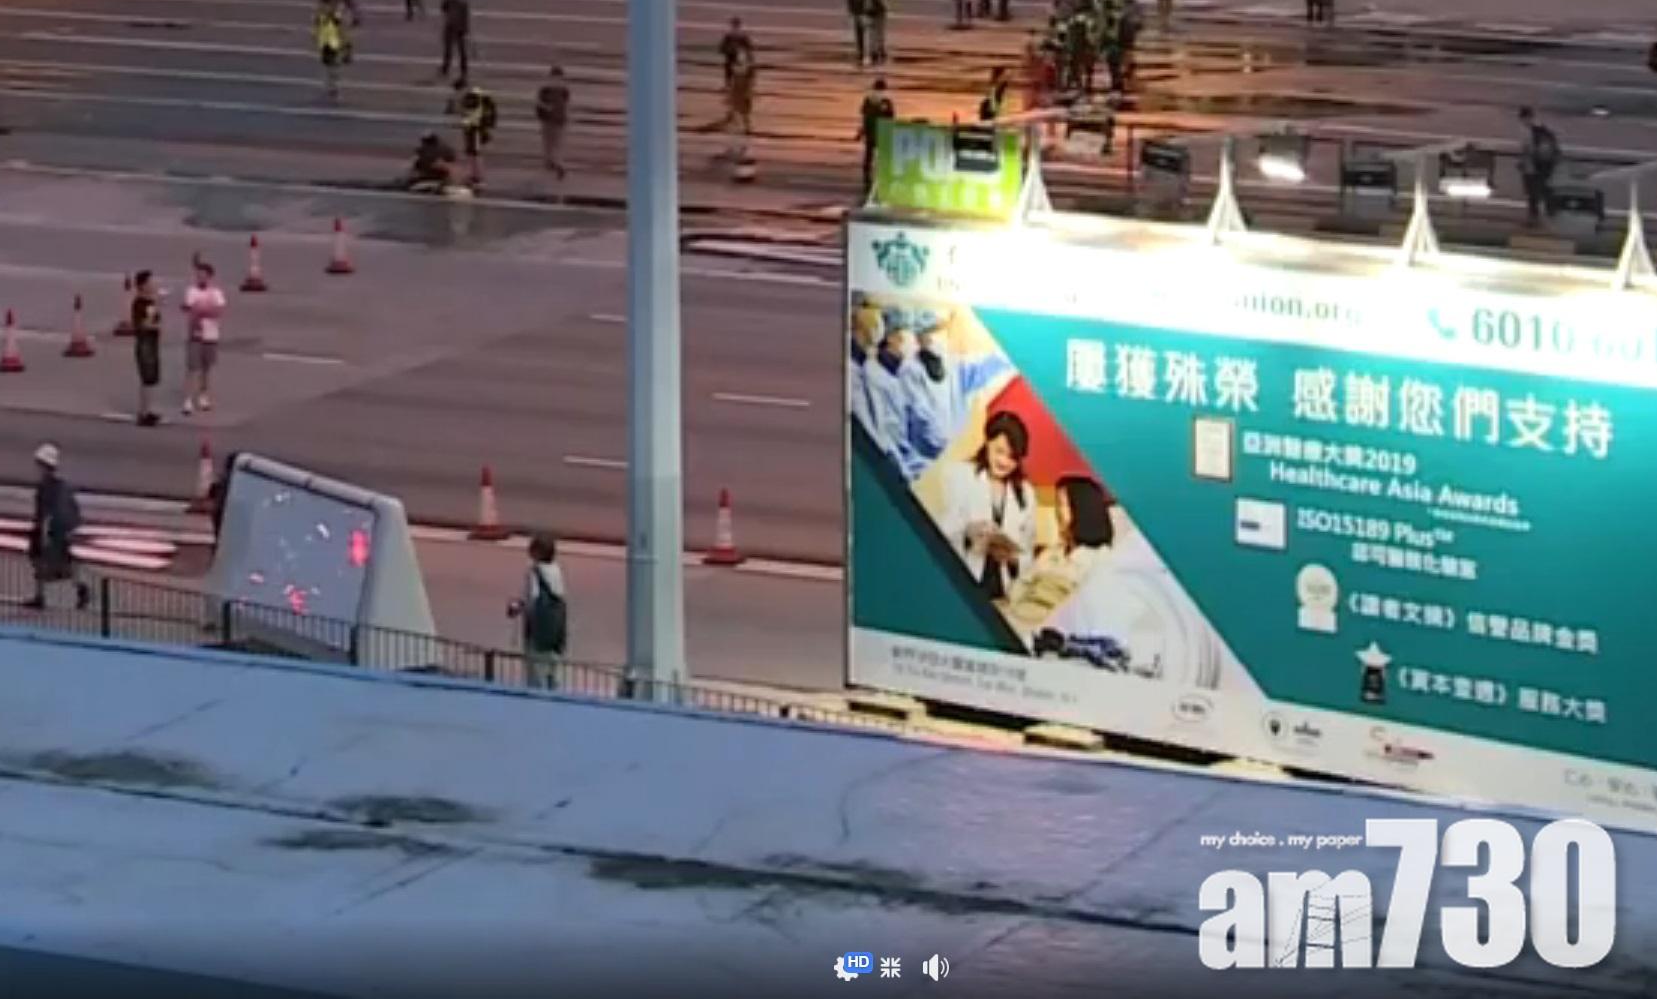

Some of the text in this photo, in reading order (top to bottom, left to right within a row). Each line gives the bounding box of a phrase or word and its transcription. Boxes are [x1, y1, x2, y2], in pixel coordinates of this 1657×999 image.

[1065, 338, 1614, 460] 屢獲殊榮 感謝您們支持
[1270, 460, 1520, 516] Healthcare Asia Awards
[1296, 507, 1391, 542] ISO15189
